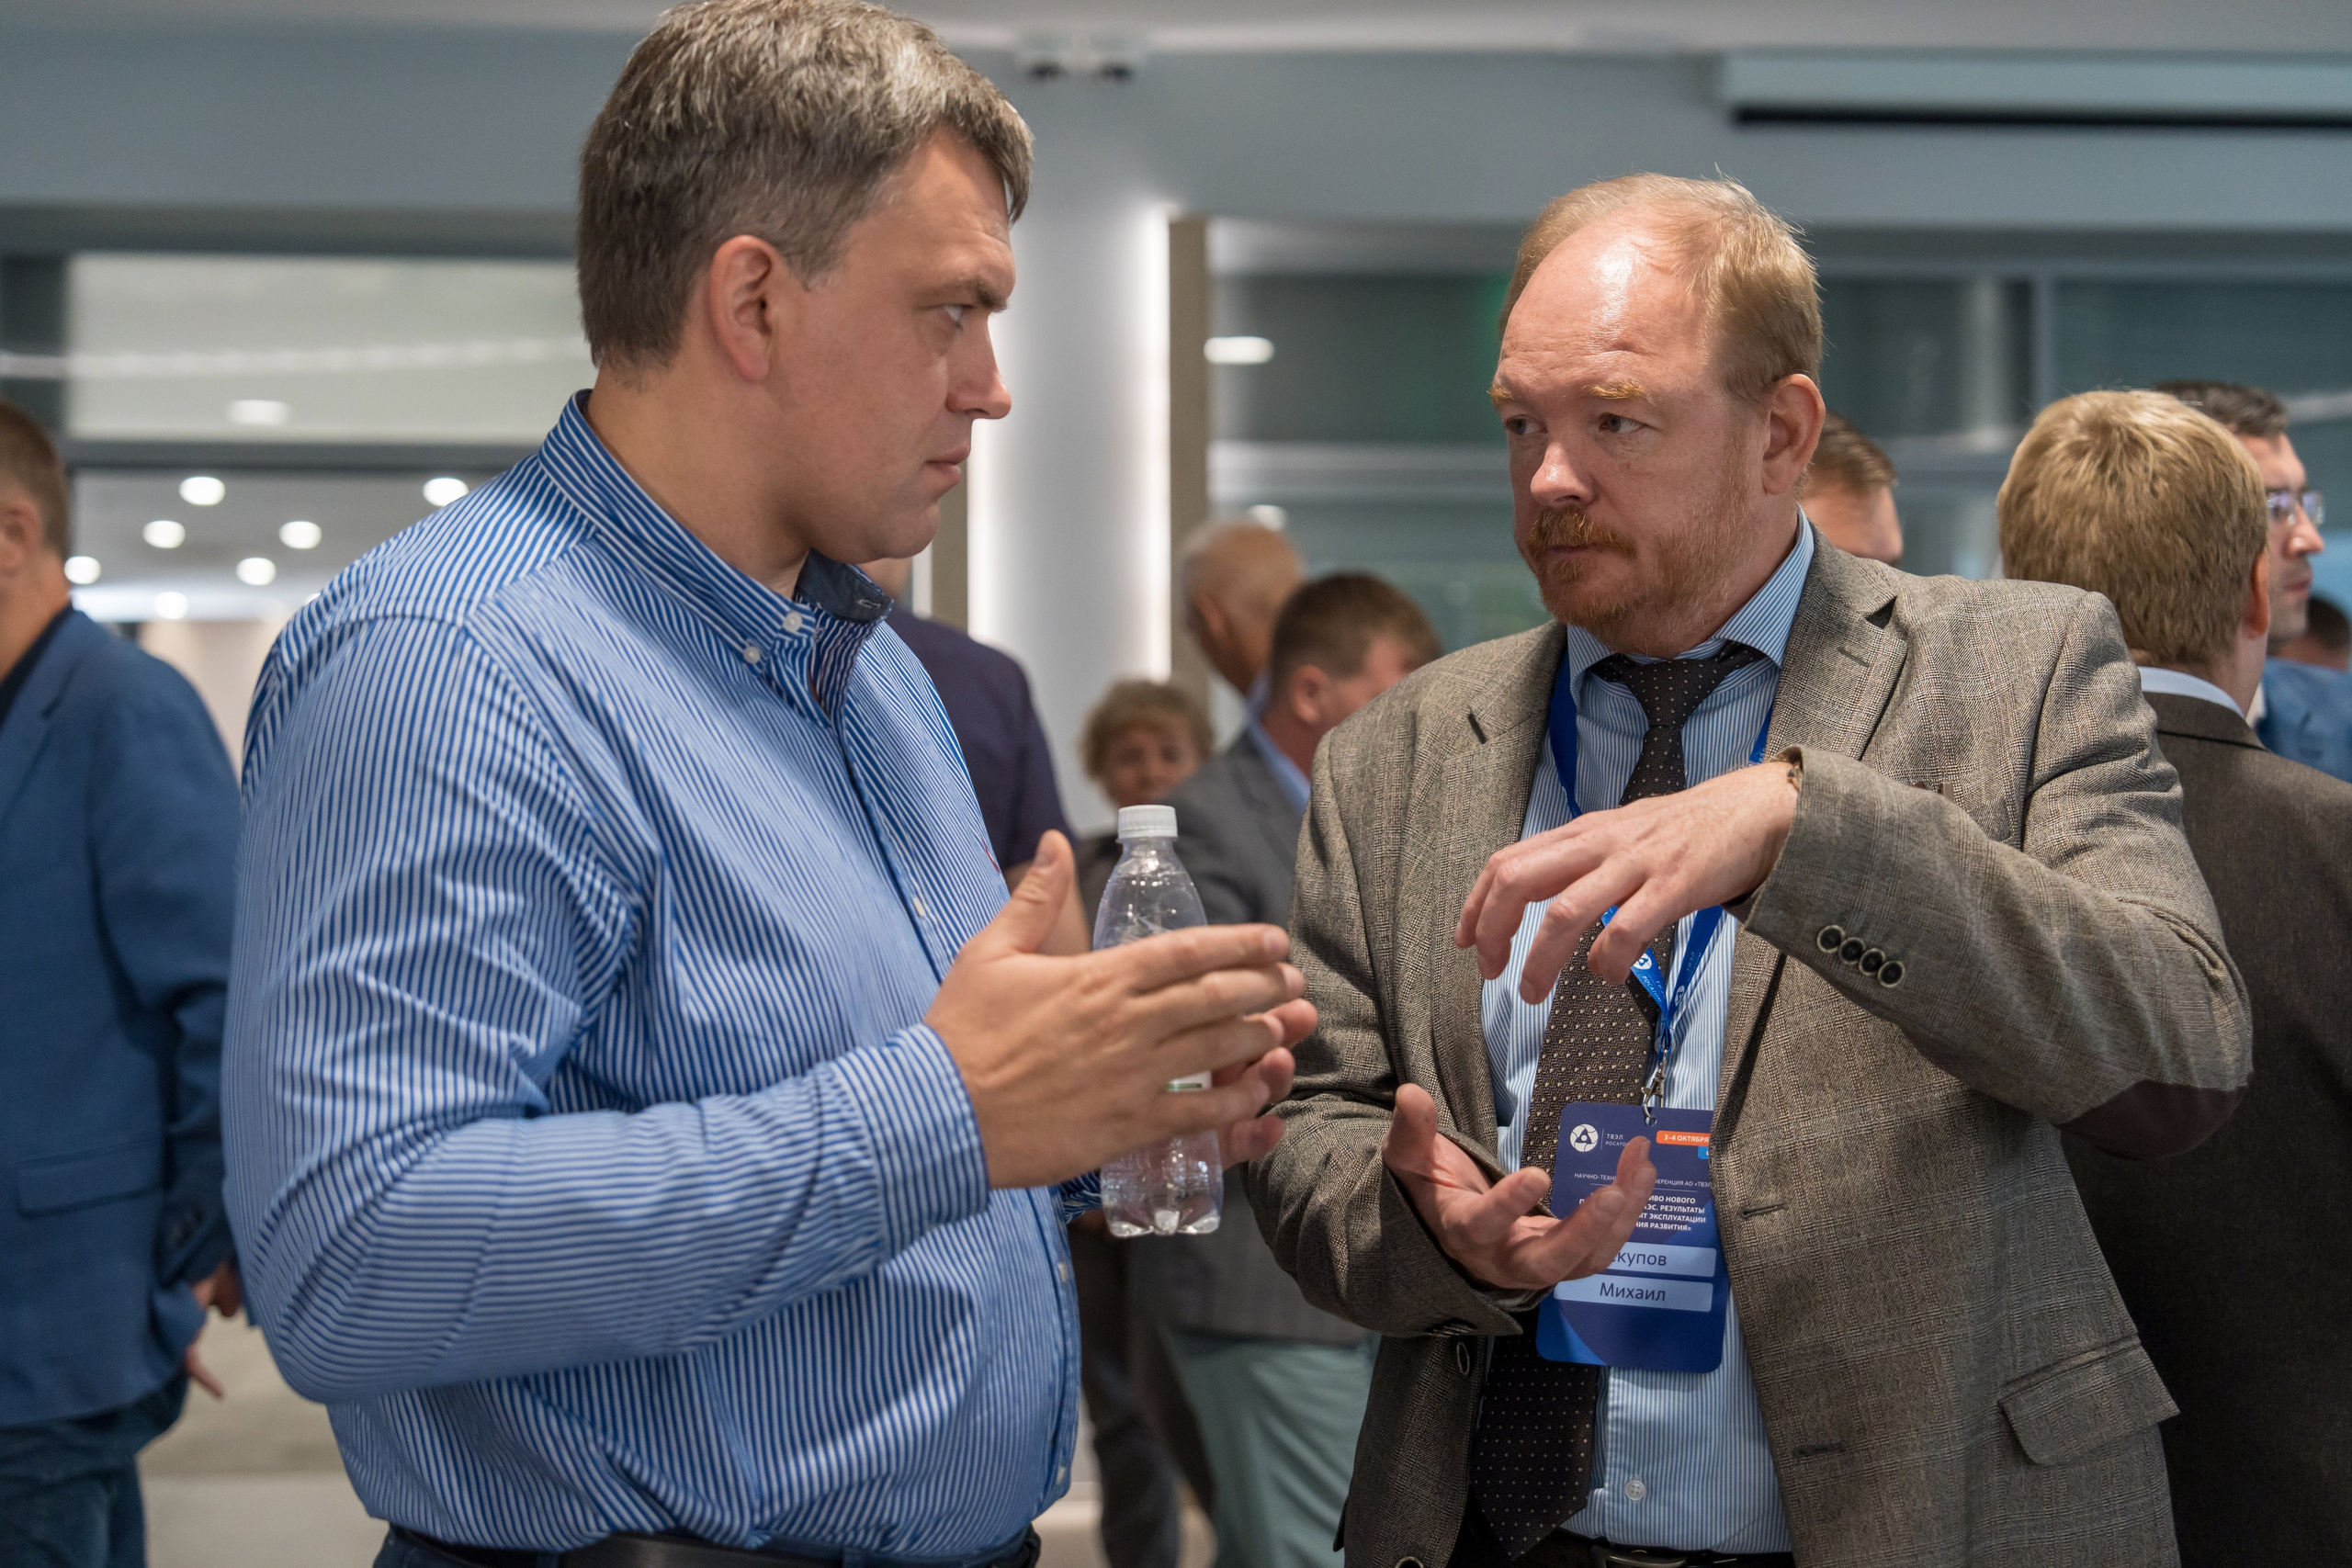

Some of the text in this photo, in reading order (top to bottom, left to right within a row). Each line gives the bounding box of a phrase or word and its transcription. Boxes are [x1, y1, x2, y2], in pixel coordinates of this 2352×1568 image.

[1660, 1205, 1705, 1213] РЕЗУЛЬТАТЫ
[1649, 1213, 1706, 1223] ЭКСПЛУАТАЦИИ
[1613, 1252, 1667, 1267] купов
[1600, 1283, 1666, 1301] Михаил
